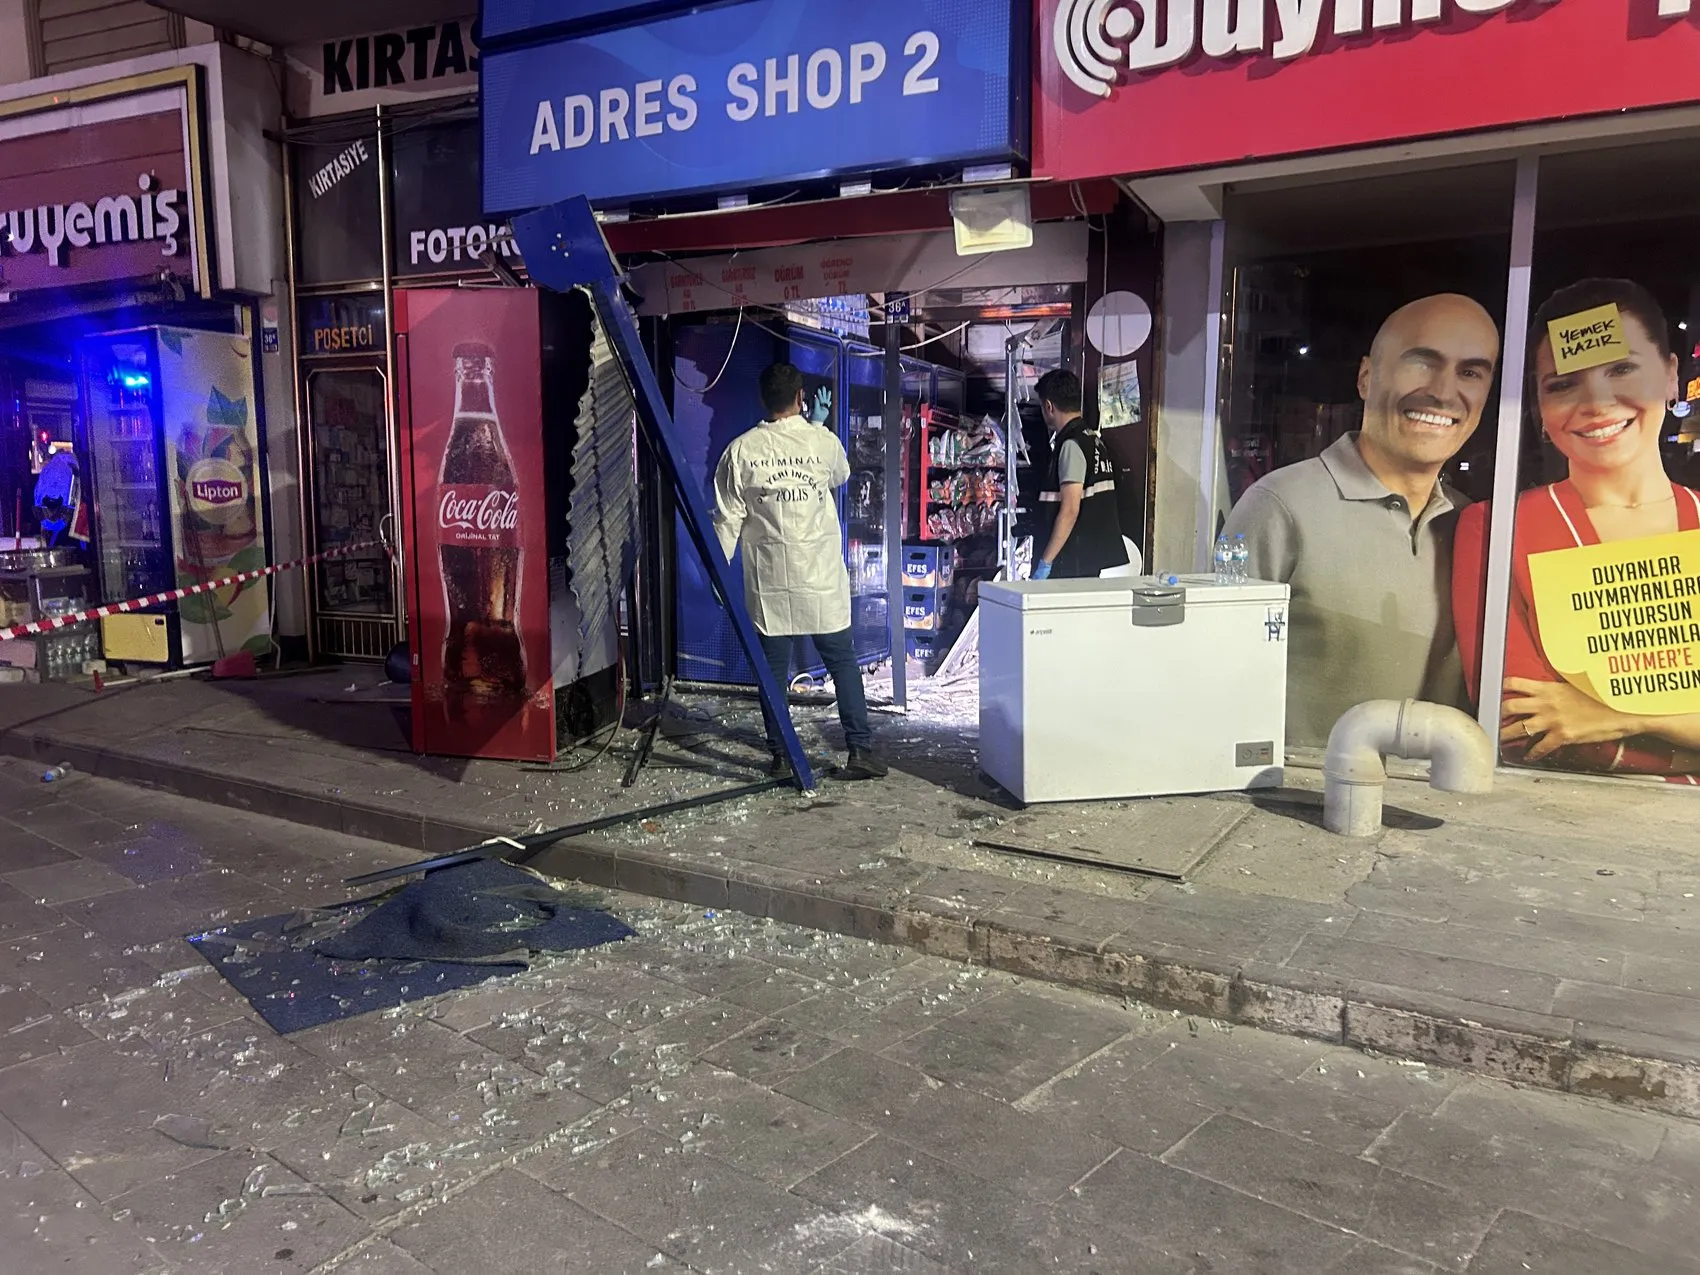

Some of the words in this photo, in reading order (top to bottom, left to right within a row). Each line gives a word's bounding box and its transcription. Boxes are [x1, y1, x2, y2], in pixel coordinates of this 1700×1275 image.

[529, 74, 698, 155] ADRES
[726, 41, 887, 122] SHOP
[903, 30, 940, 96] 2
[308, 139, 369, 199] KIRTASİYE
[1559, 319, 1615, 344] YEMEK
[1561, 334, 1621, 359] HAZIR
[197, 484, 238, 500] Lipton
[907, 563, 927, 574] EFES
[1592, 555, 1681, 586] DUYANLAR
[905, 606, 926, 616] EFES
[1599, 601, 1692, 630] DUYURSUN
[1608, 647, 1693, 675] DUYMER'E
[1610, 669, 1700, 697] BUYURSUN
